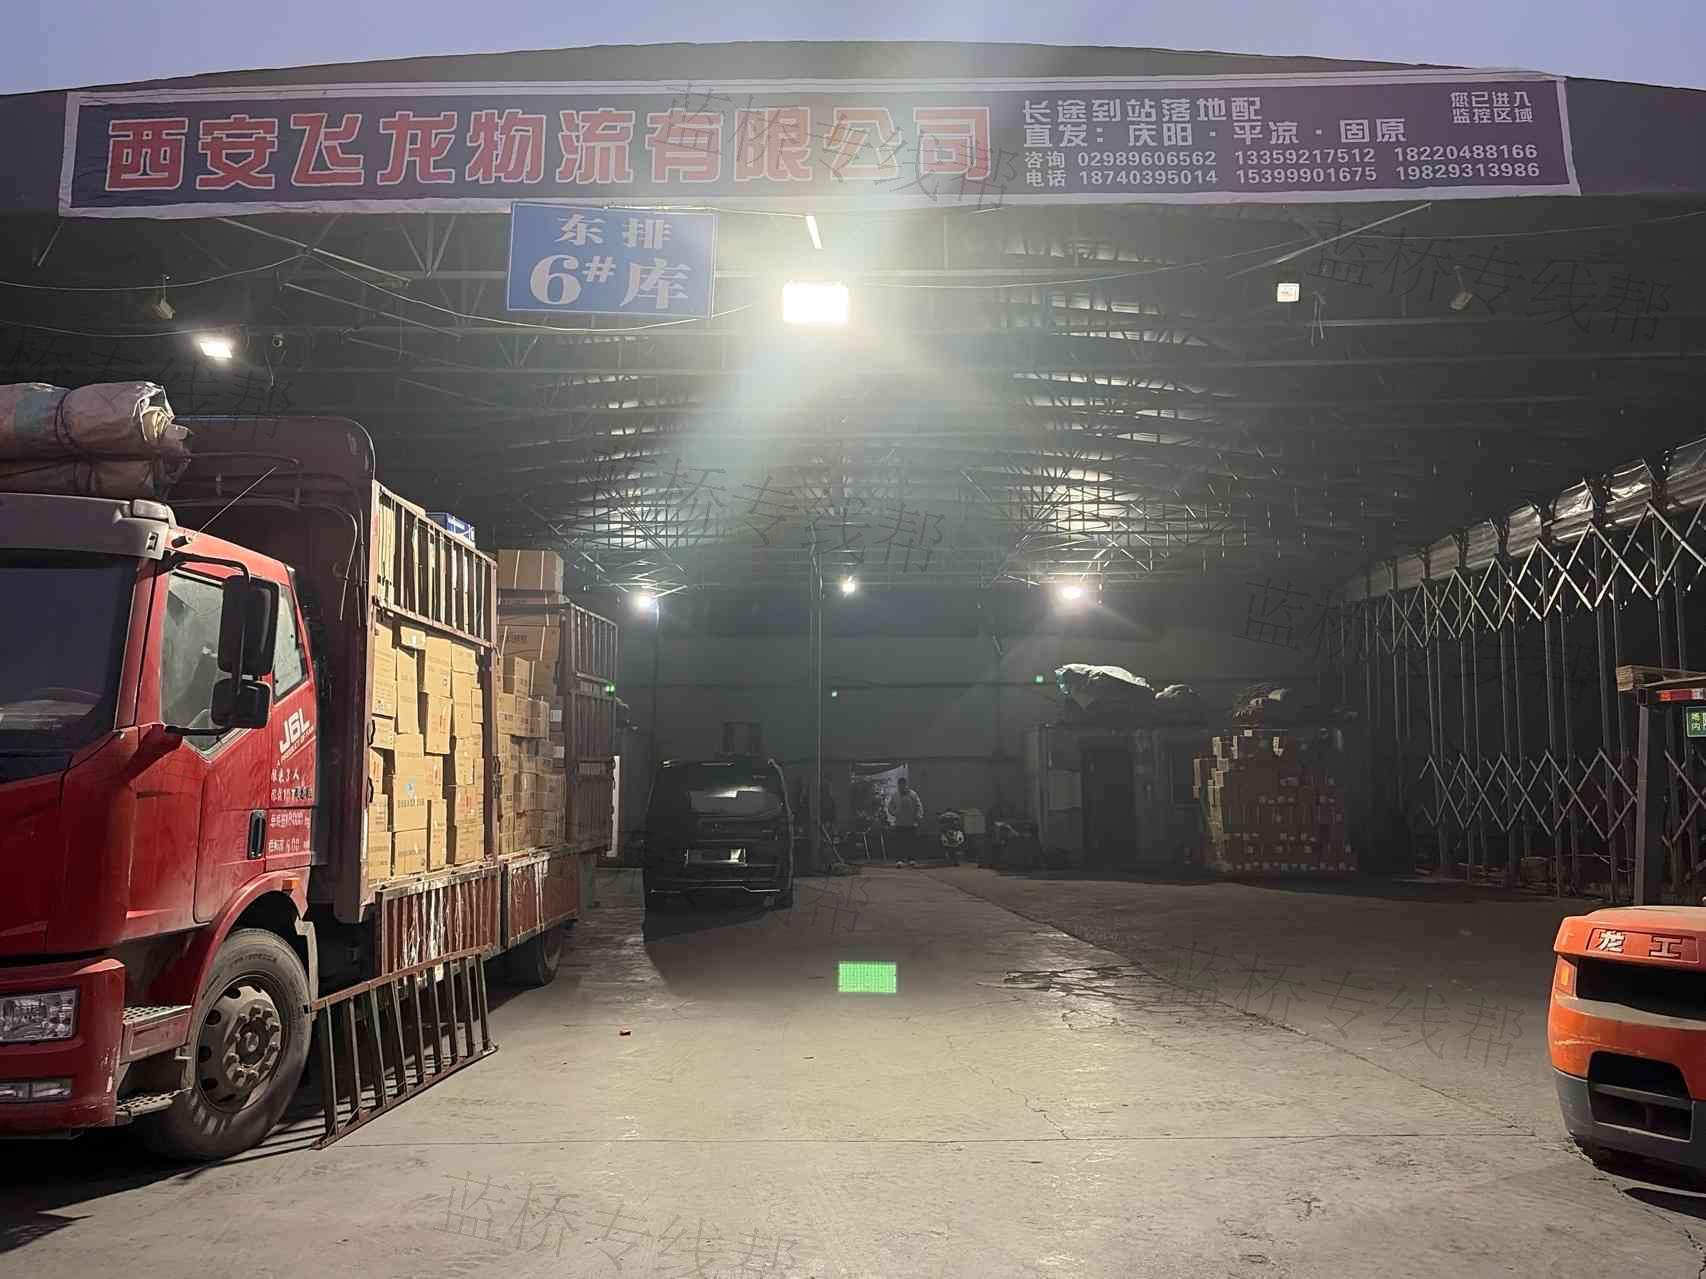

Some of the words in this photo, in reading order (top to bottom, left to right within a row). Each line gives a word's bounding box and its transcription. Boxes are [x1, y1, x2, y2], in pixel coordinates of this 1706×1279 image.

[1023, 97, 1263, 123] 长途到站落地配
[1450, 91, 1532, 108] 您已进入
[1452, 108, 1533, 124] 监控区域
[104, 106, 991, 192] 西安飞龙物流有限公司
[1025, 151, 1065, 169] 咨询
[1077, 151, 1217, 167] 02989606562
[1235, 148, 1376, 165] 13359217512
[1394, 144, 1538, 162] 18220488166
[1026, 169, 1066, 187] 电话
[1079, 170, 1218, 185] 18740395014
[1236, 167, 1377, 184] 15399901675
[1395, 163, 1540, 181] 19829313986
[555, 213, 672, 249] 东排
[529, 254, 690, 311] 6#库
[1597, 929, 1682, 959] 龙工
